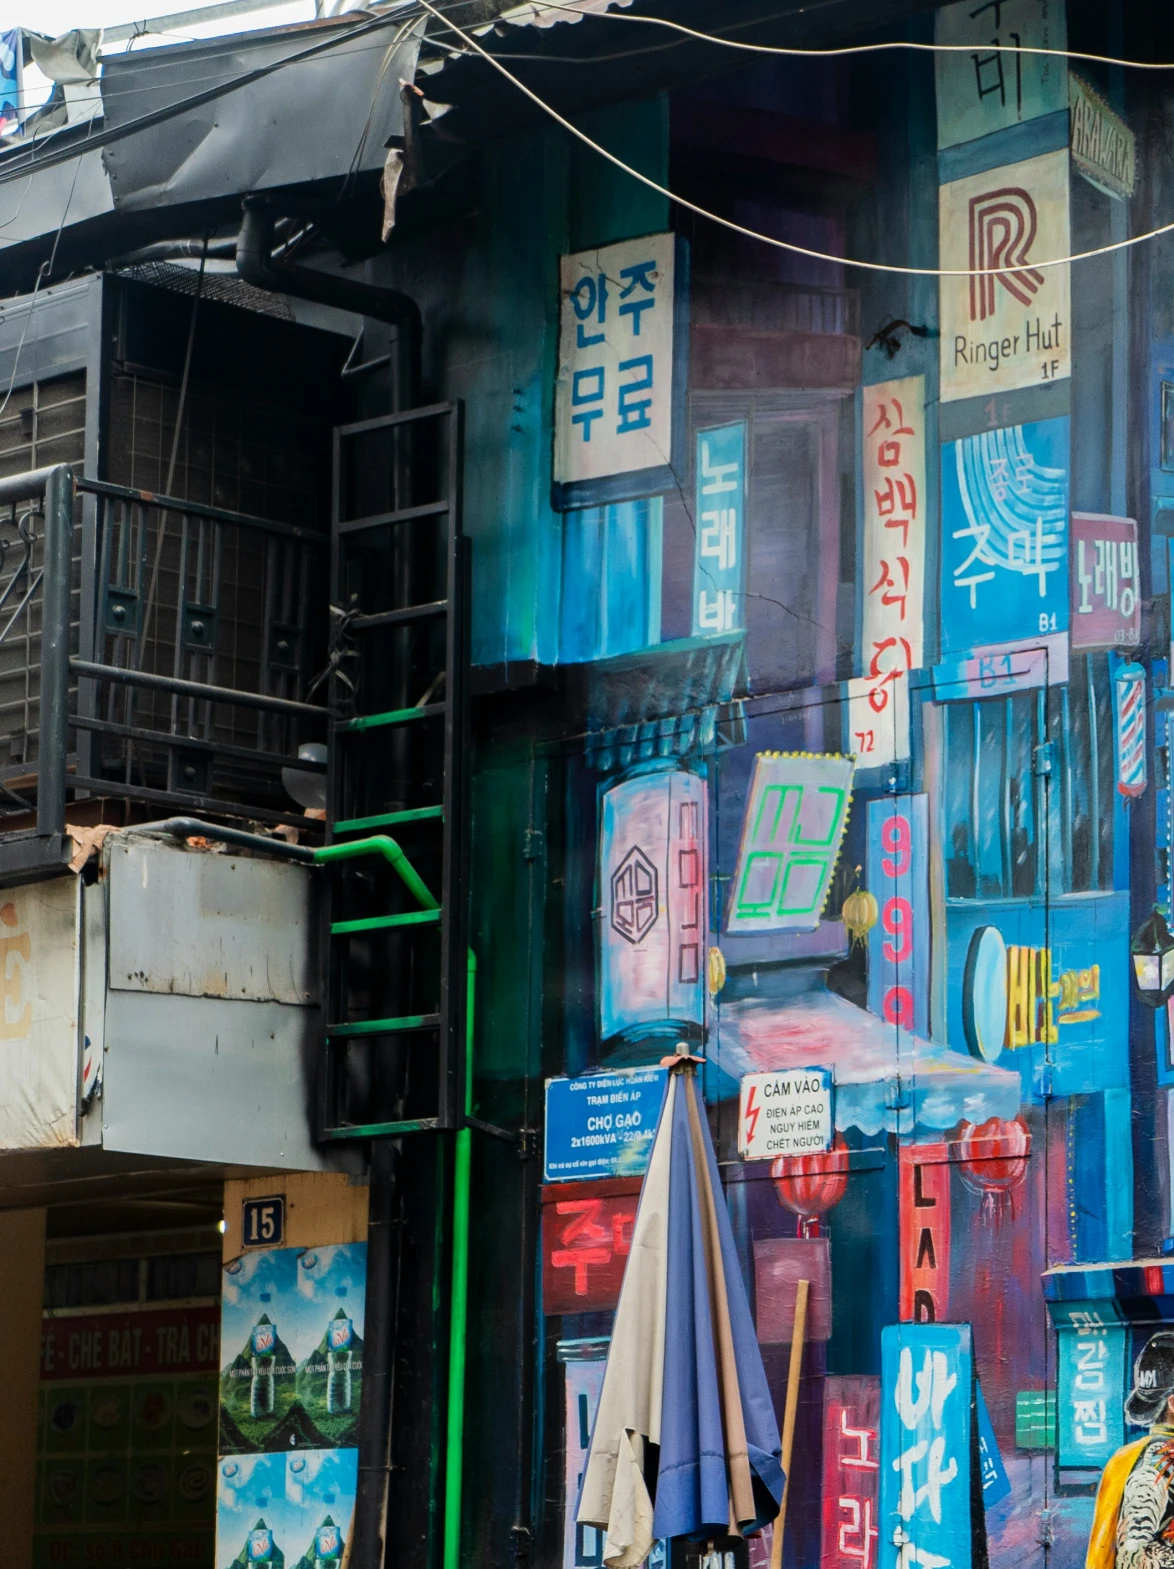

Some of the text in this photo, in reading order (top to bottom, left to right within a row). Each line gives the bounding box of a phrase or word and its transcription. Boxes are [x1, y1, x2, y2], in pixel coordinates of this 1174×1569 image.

[954, 312, 1063, 371] Ringer Hut
[1041, 360, 1060, 380] 1F
[1077, 539, 1140, 619] 노래방
[1038, 612, 1059, 633] B1
[978, 652, 1018, 690] B1
[794, 1076, 820, 1095] VÀO
[804, 1103, 824, 1115] CAO
[587, 1113, 613, 1133] CHỢ
[770, 1122, 796, 1134] NGUY
[249, 1205, 276, 1243] 15
